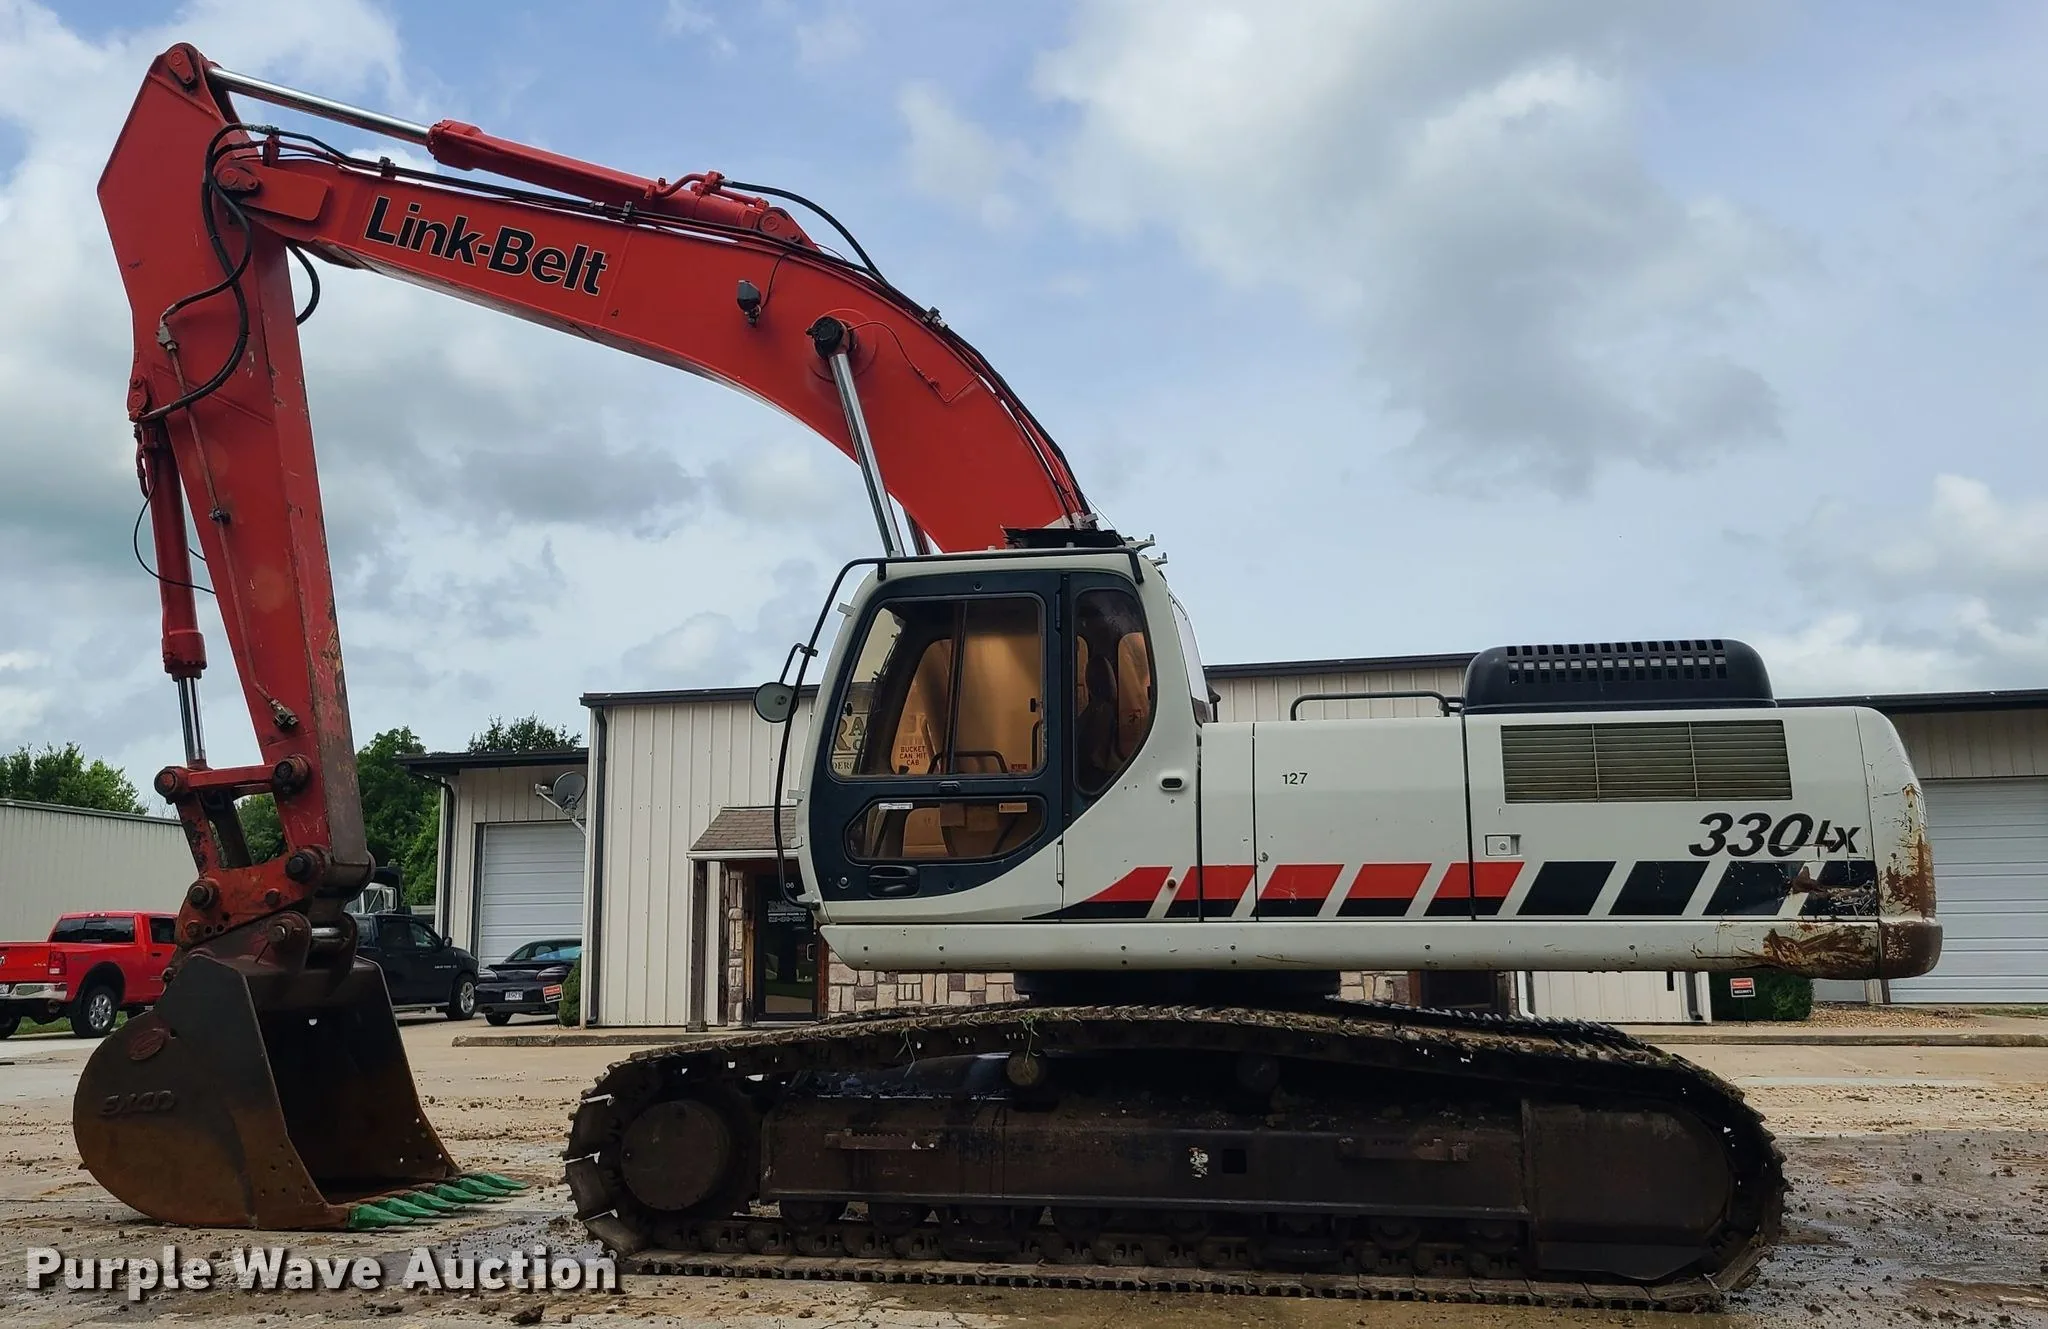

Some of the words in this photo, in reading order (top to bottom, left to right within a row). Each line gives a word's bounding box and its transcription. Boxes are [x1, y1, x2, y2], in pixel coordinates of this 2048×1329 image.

[364, 196, 608, 296] Link-Belt
[900, 745, 926, 753] BUCKET
[1282, 772, 1308, 785] 127
